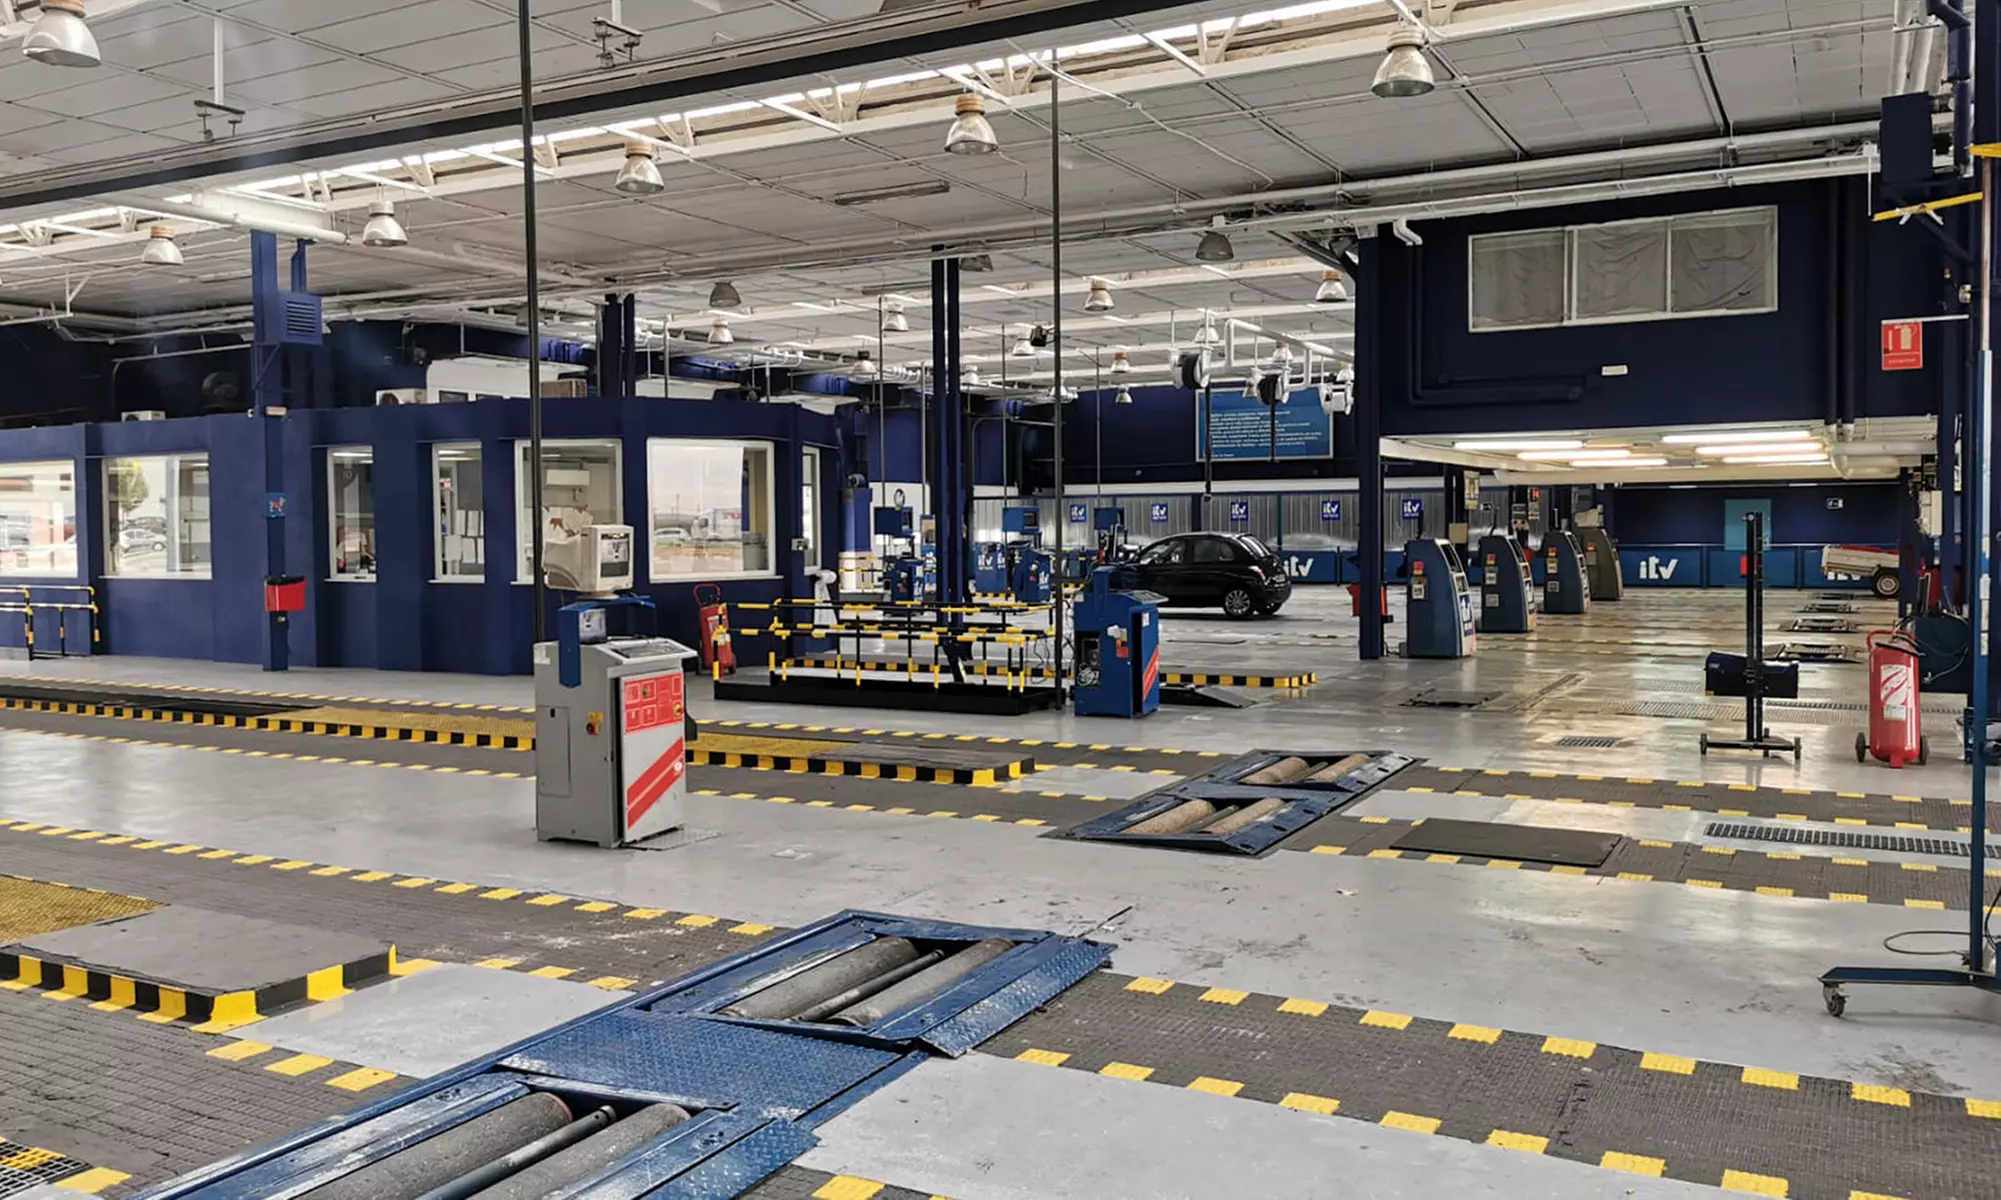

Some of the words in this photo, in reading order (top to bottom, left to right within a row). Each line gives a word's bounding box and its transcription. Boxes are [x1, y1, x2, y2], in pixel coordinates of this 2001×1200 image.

[1071, 504, 1085, 516] itv
[1152, 504, 1167, 516] itv
[1231, 503, 1247, 515] itv
[1323, 502, 1339, 514] itv
[1403, 501, 1420, 513] itv
[1283, 555, 1314, 577] itv
[1640, 556, 1679, 580] itv
